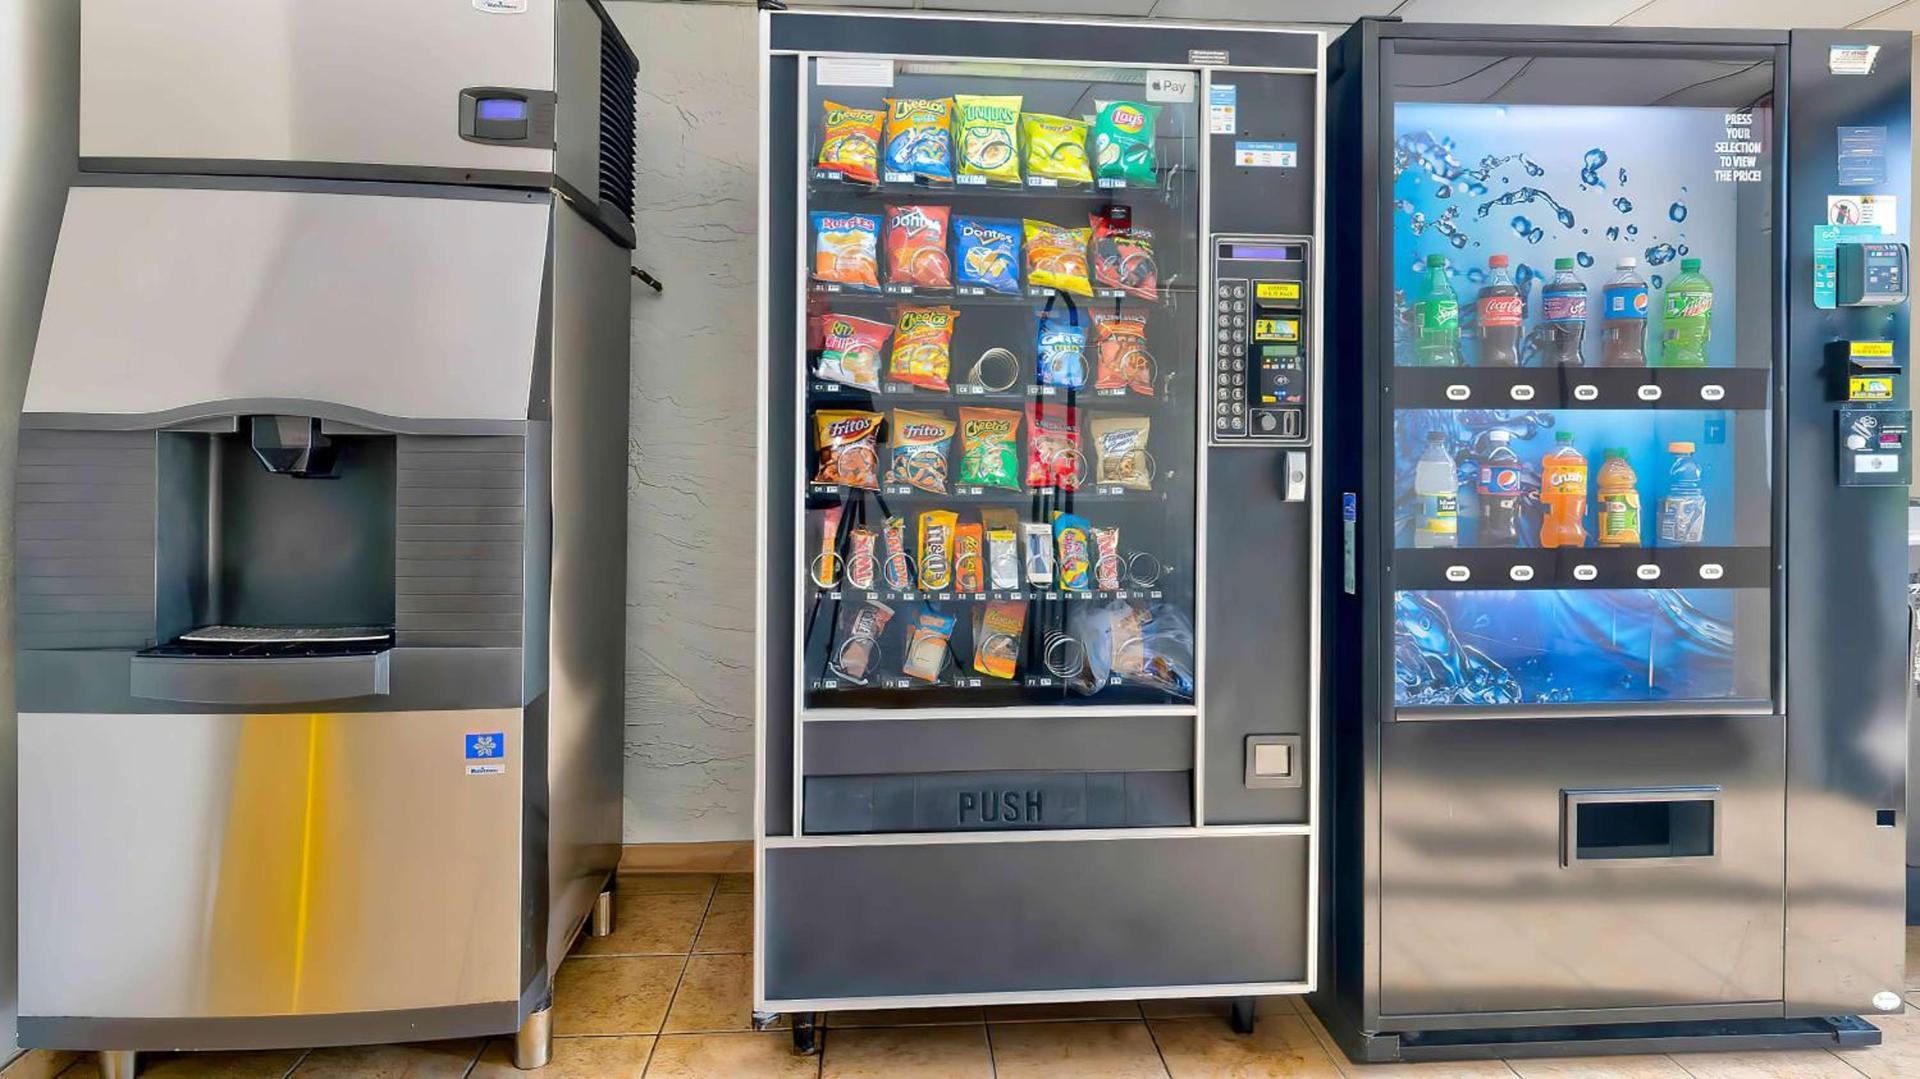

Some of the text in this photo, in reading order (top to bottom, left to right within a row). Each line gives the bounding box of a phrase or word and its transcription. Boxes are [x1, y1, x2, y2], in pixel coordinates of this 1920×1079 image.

[1164, 80, 1186, 94] Pay
[894, 99, 947, 120] Cheetos
[1113, 109, 1145, 127] Lay's
[1725, 114, 1752, 125] PRESS
[1726, 128, 1751, 139] YOUR
[1714, 142, 1762, 153] SELECTION
[1720, 156, 1757, 167] TO VIEW
[1714, 170, 1732, 182] THE
[822, 215, 876, 231] RUFFLES
[962, 226, 1015, 245] Doritos
[901, 312, 948, 333] Cheetos
[829, 417, 872, 438] Fritos
[904, 423, 945, 438] Fritos
[965, 419, 1011, 437] Cheetos
[1551, 473, 1583, 485] Crush
[957, 790, 1042, 824] PUSH
